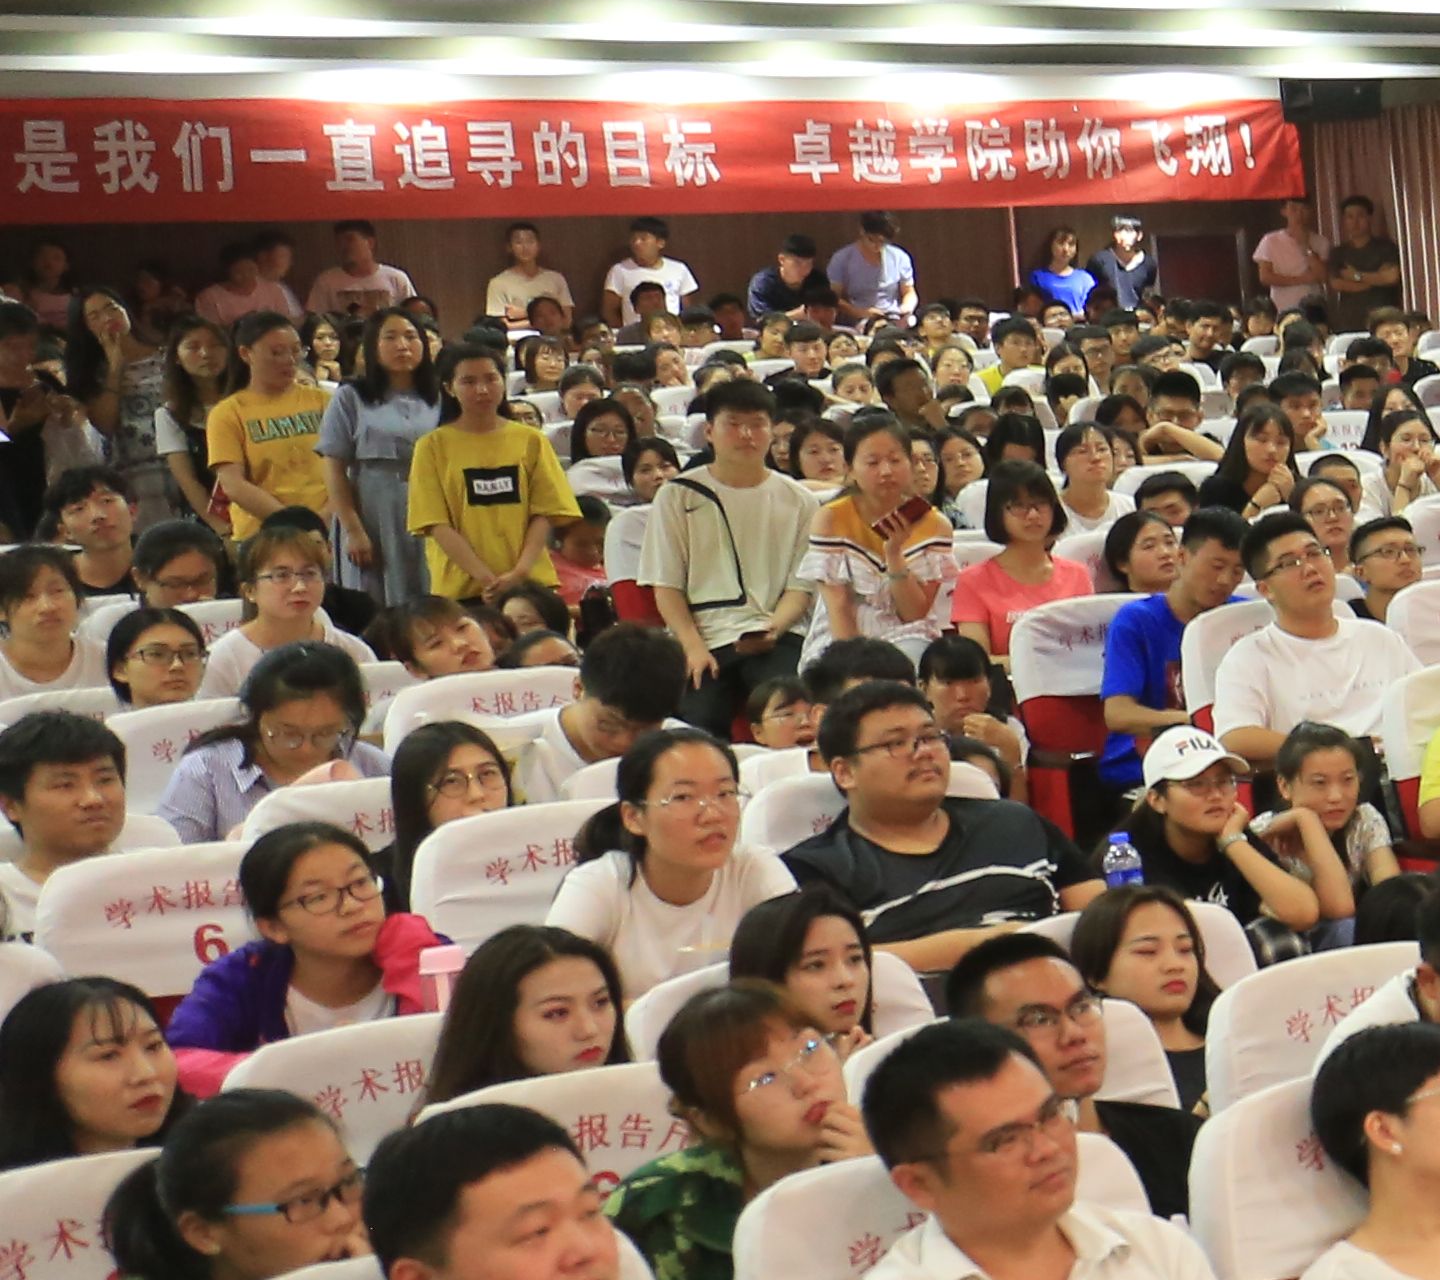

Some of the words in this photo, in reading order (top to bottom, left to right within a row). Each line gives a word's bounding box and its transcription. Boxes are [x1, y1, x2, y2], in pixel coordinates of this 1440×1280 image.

[13, 118, 721, 194] 是我们一直追寻的目标
[1175, 737, 1220, 757] FILA
[485, 837, 580, 886] 学术报
[104, 880, 247, 930] 学术报告
[193, 923, 230, 966] 6
[1286, 984, 1375, 1044] 学术报
[314, 1058, 430, 1119] 学术报
[574, 1113, 689, 1151] 报告厅
